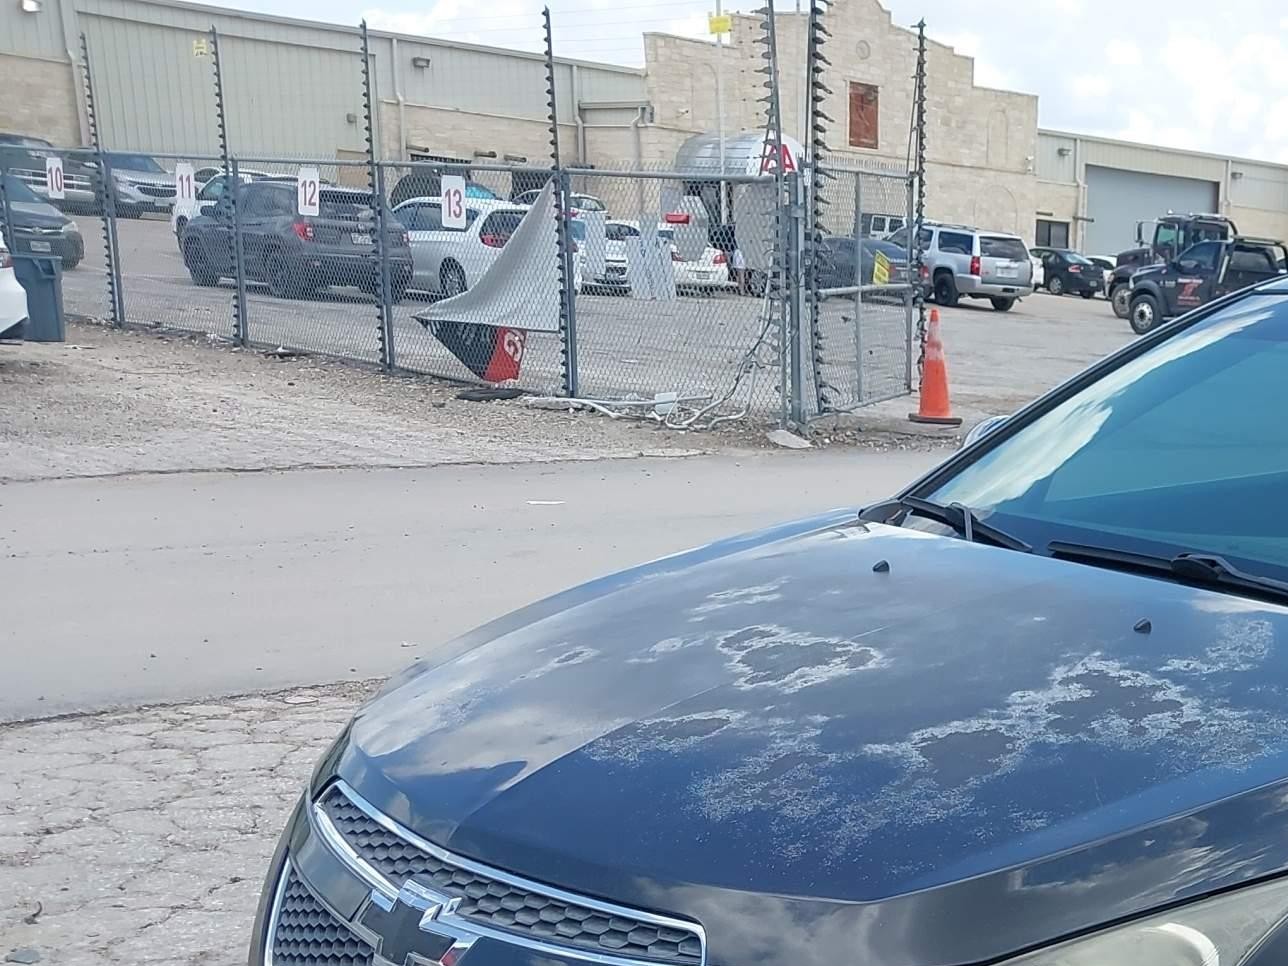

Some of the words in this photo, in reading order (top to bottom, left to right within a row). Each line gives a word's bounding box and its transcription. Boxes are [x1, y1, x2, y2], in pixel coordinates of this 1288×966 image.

[47, 165, 63, 193] 10
[178, 173, 192, 199] 11
[301, 180, 317, 207] 12
[444, 187, 463, 219] 13
